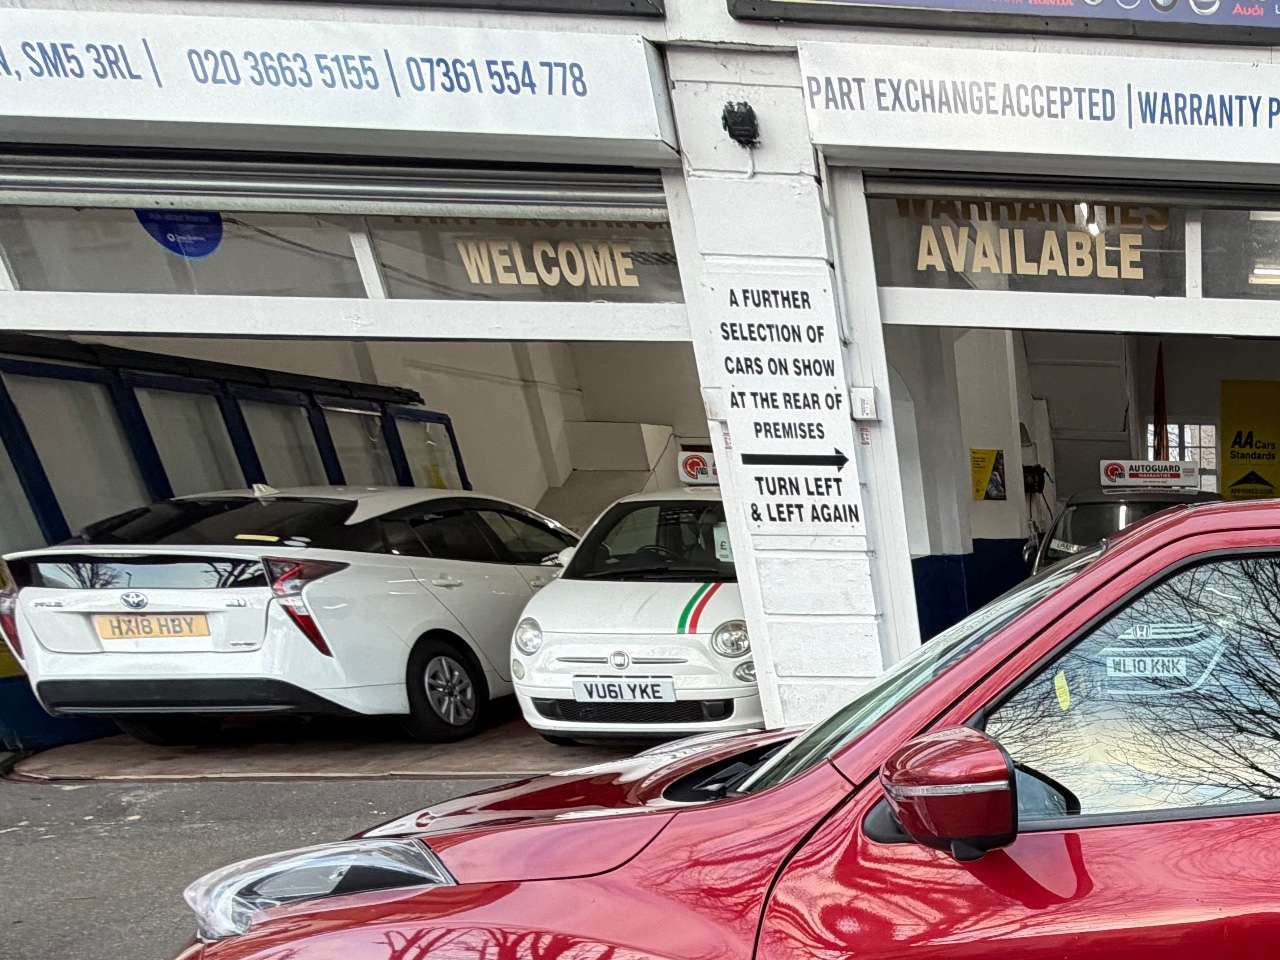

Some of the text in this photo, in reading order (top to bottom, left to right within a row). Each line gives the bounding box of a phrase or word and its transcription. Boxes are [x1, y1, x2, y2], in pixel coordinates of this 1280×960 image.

[1232, 3, 1264, 17] Audi
[21, 40, 85, 79] SM5
[85, 43, 143, 80] 3RL
[187, 47, 241, 87] 020
[243, 48, 313, 90] 3663
[315, 53, 380, 93] 5155
[405, 55, 483, 95] 07361
[486, 58, 537, 96] 554
[538, 60, 588, 98] 778
[806, 75, 867, 112] PART
[874, 77, 998, 117] EXCHANGE
[1001, 82, 1116, 123] ACCEPTED
[1137, 90, 1262, 130] WARRANTY
[916, 224, 1144, 280] AVAILABLE
[456, 239, 640, 288] WELCOME
[729, 288, 811, 310] A FURTHER
[720, 322, 825, 343] SELECTION OF
[724, 356, 835, 377] CARS ON SHOW
[730, 391, 746, 409] AT
[750, 392, 779, 410] THE
[783, 392, 821, 410] REAR
[825, 393, 842, 410] OF
[754, 421, 825, 440] PREMISES
[1230, 430, 1276, 450] AA Cars
[1230, 450, 1276, 460] Standards
[1129, 464, 1180, 473] AUTOGUARD
[754, 476, 842, 497] TURN LEFT
[751, 503, 860, 523] & LEFT AGAIN
[157, 616, 195, 635] HBY
[1151, 658, 1181, 674] KNK
[584, 683, 662, 700] VU61 YKE
